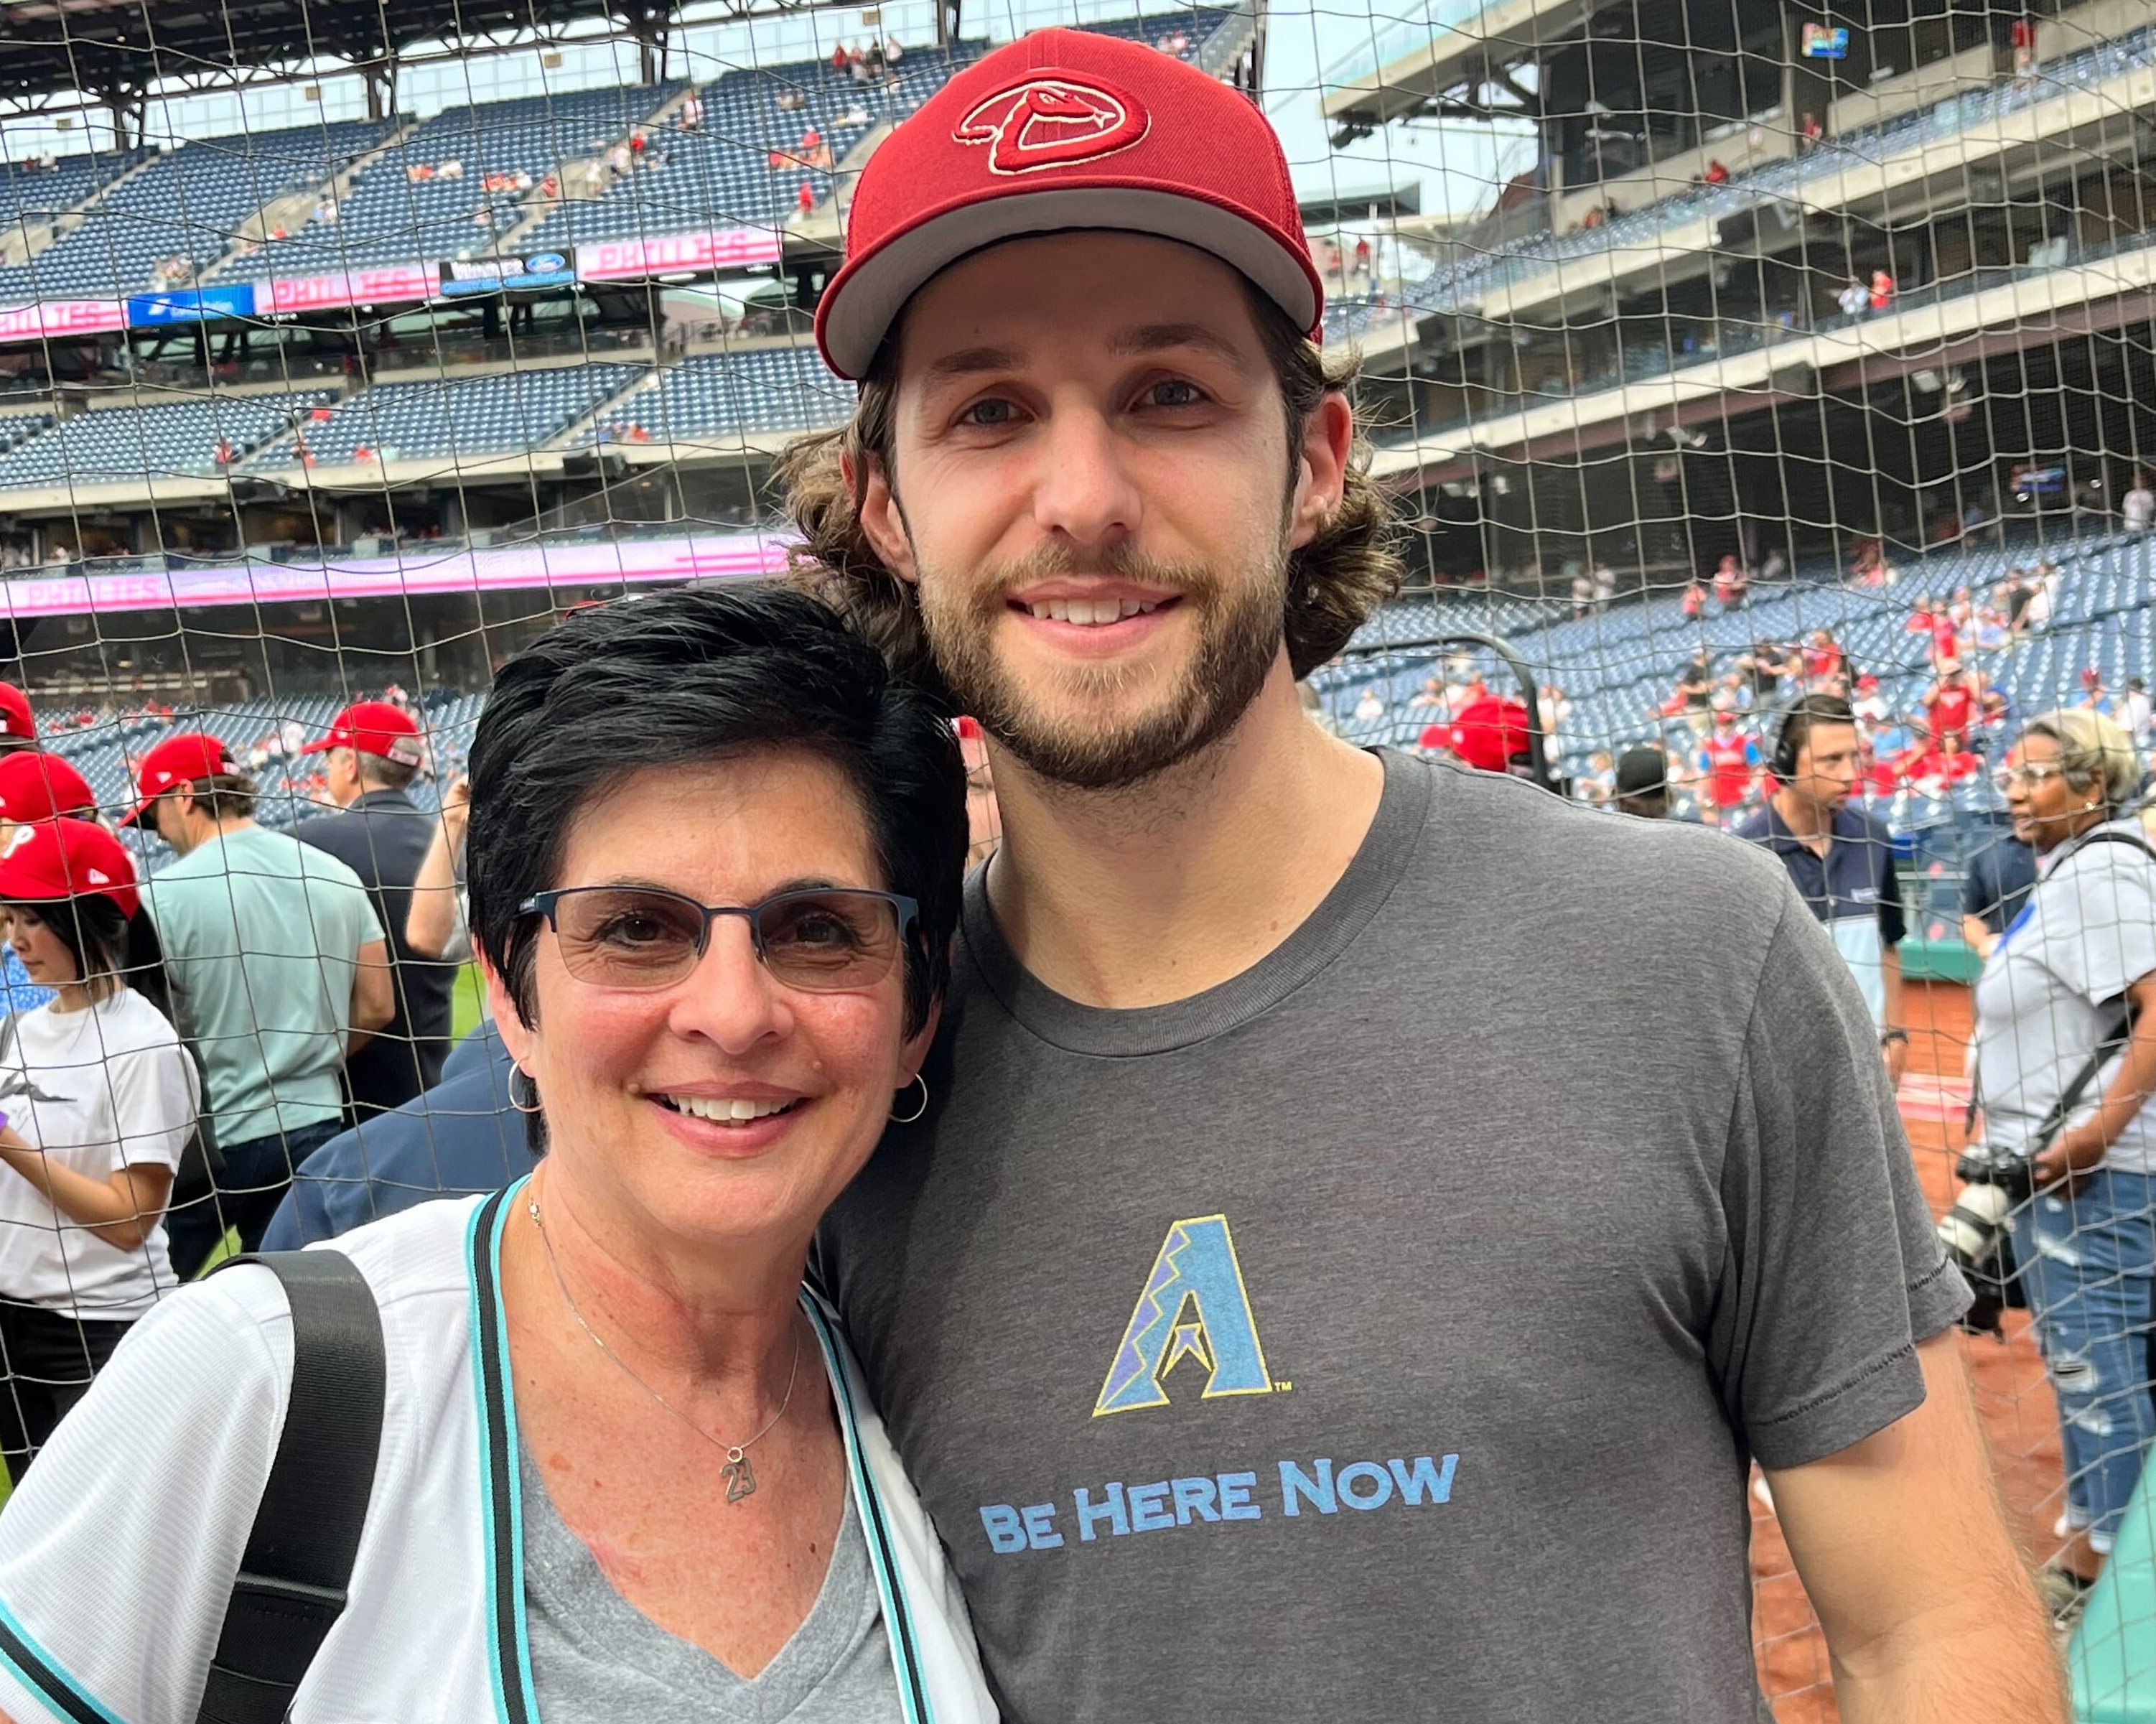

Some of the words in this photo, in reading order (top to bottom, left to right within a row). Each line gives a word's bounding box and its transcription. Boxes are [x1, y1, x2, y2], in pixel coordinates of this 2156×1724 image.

[599, 232, 747, 269] PHILLIES
[28, 575, 159, 606] PHILLIES
[3, 825, 34, 859] P
[719, 1458, 757, 1503] 23
[979, 1503, 1065, 1554] BE
[1073, 1471, 1261, 1542] HERE
[1278, 1454, 1460, 1517] NOW
